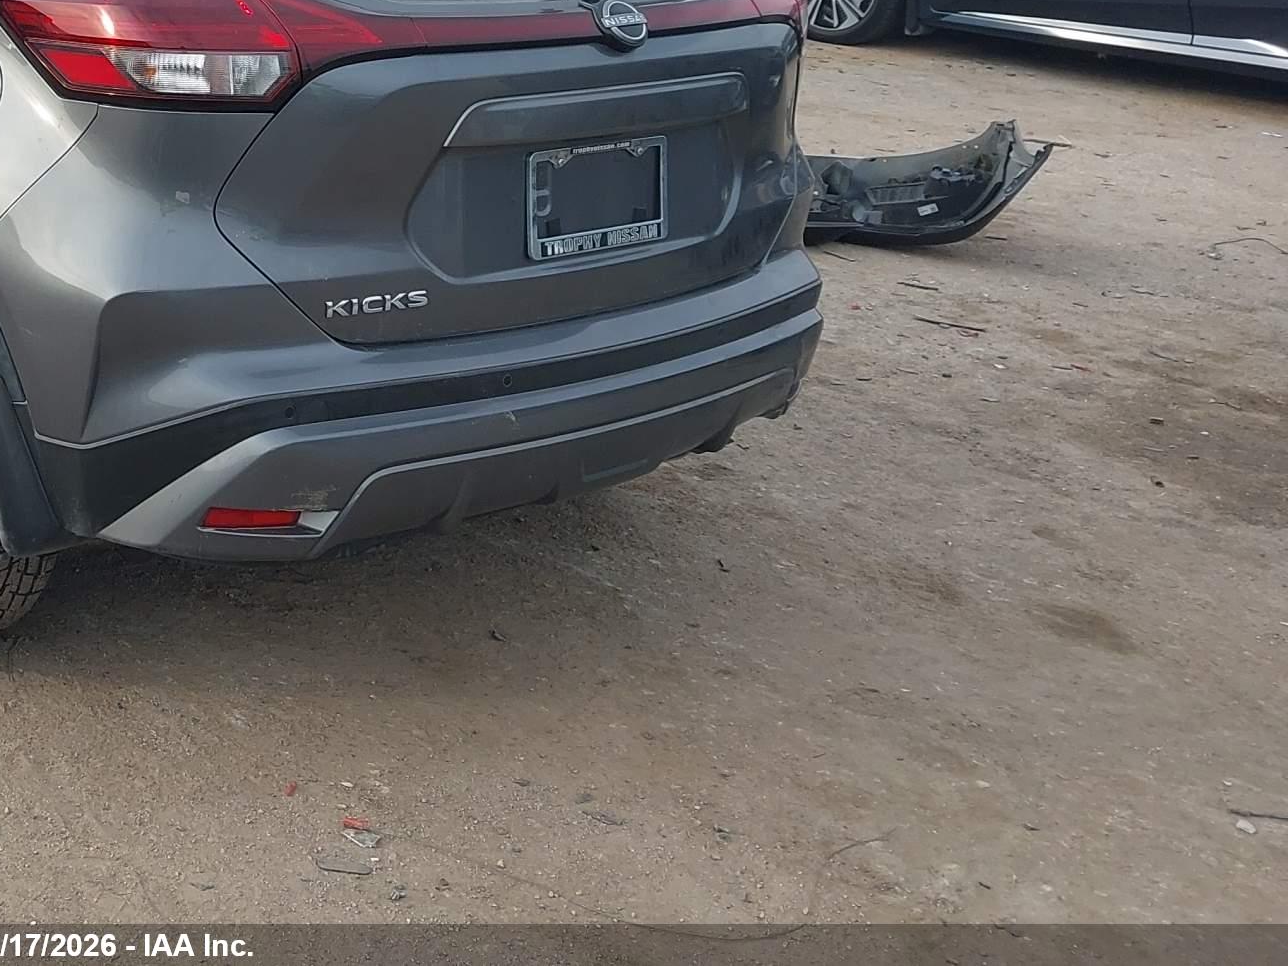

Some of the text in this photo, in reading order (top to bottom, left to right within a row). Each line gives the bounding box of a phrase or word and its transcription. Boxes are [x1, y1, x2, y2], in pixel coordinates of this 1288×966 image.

[544, 223, 658, 256] TROPHY NISSAN
[325, 290, 428, 319] KICKS
